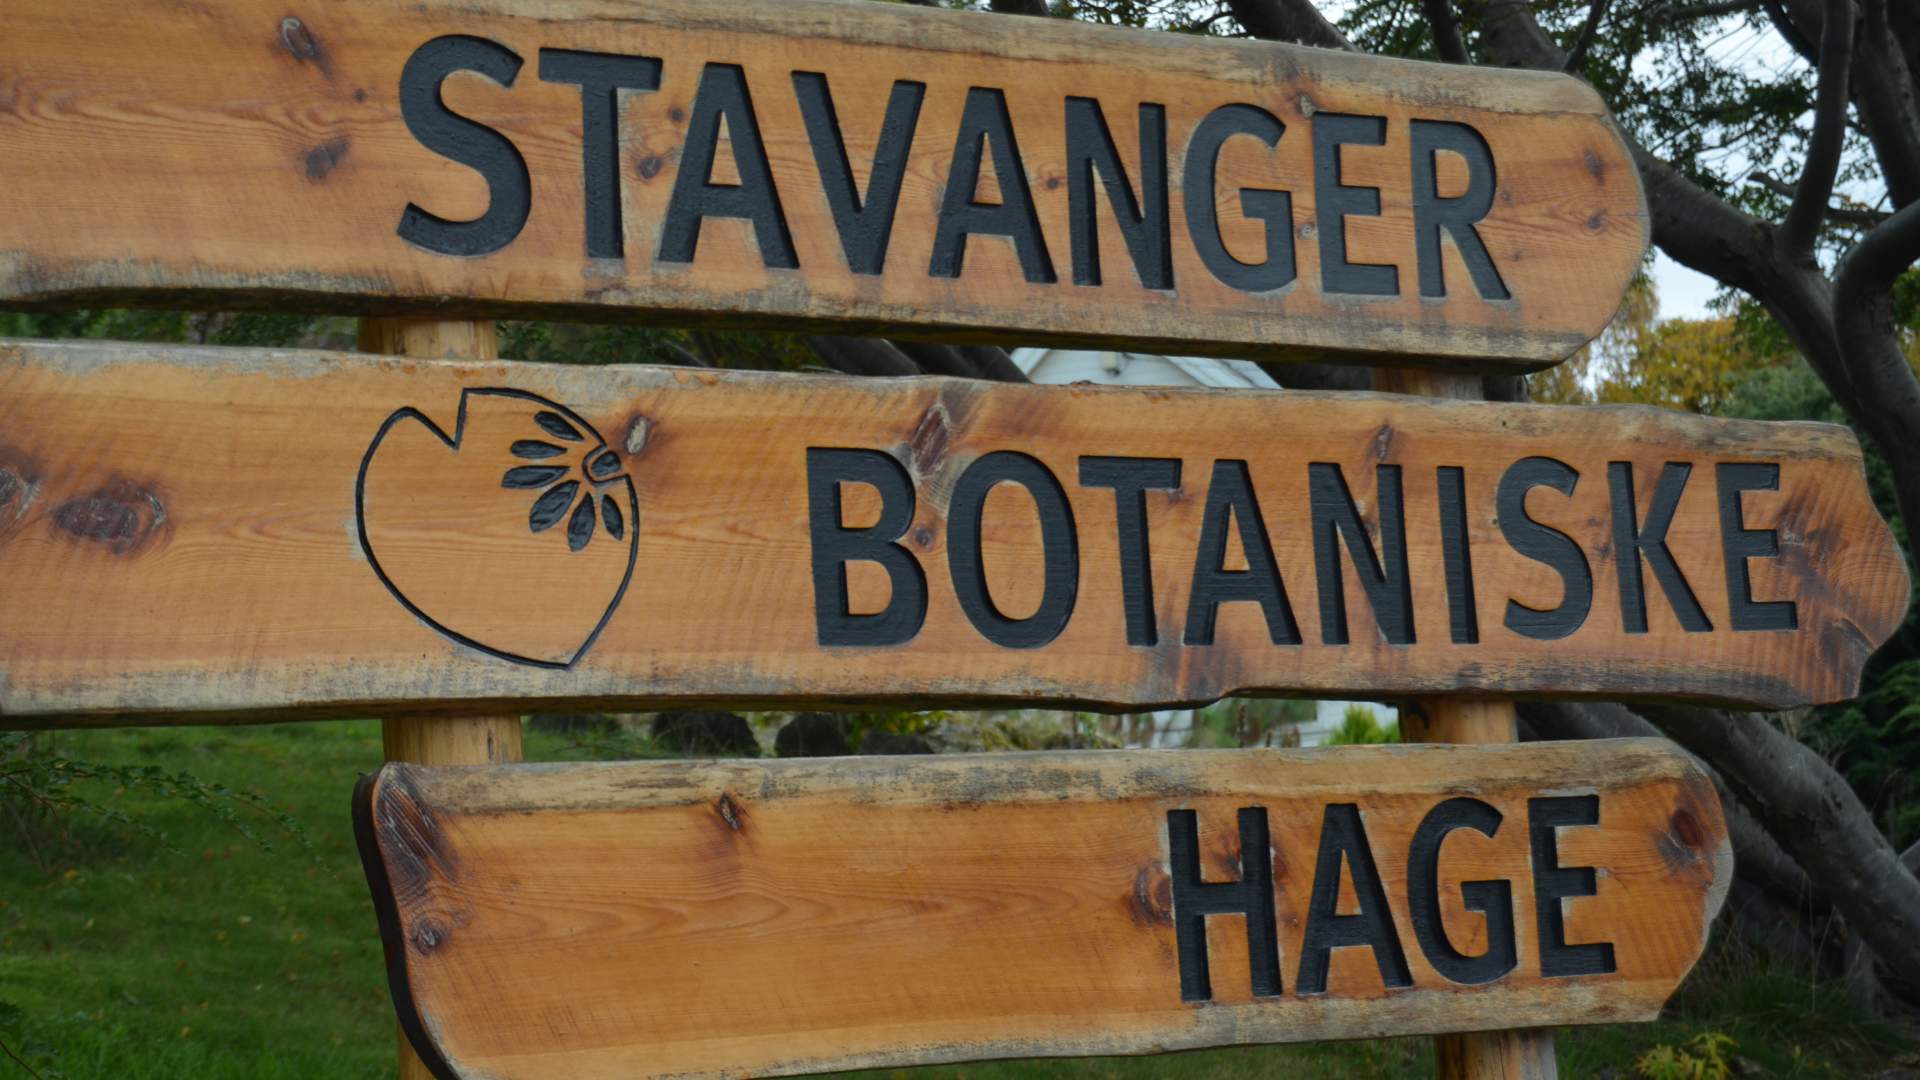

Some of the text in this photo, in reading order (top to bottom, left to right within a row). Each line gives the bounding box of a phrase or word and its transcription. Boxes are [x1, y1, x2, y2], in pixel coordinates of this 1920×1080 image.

[397, 34, 1511, 300] STAVANGER
[807, 447, 1799, 648] BOTANISKE
[1167, 794, 1617, 1002] HAGE
